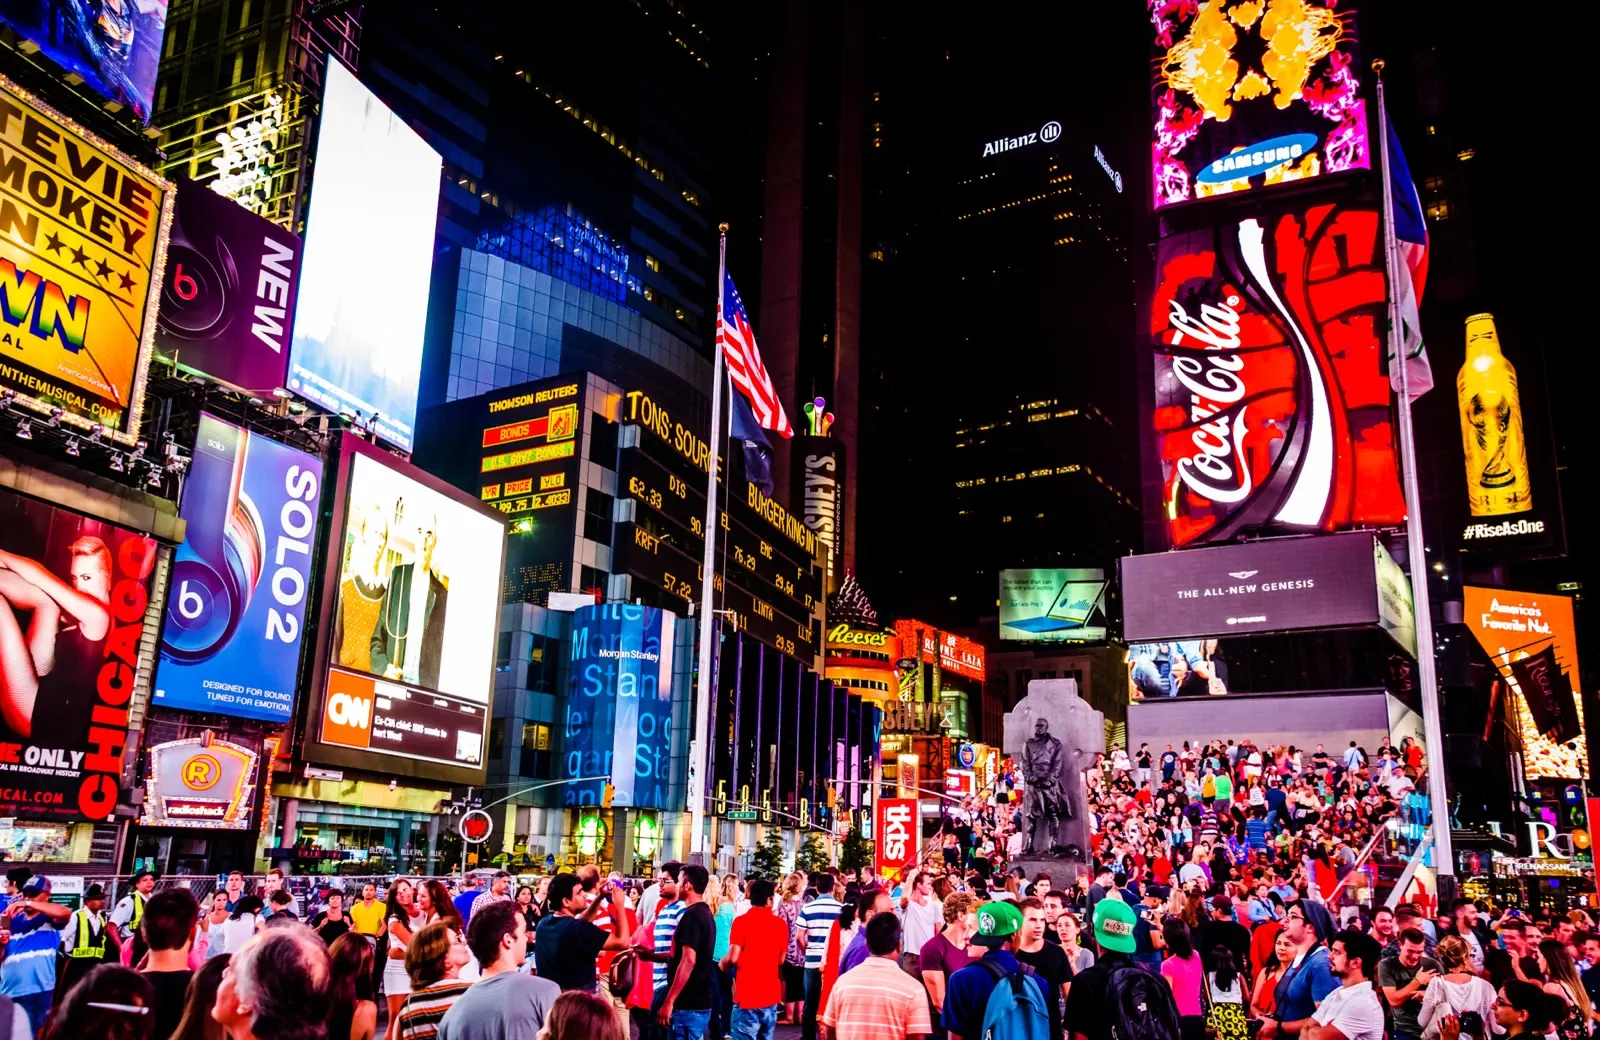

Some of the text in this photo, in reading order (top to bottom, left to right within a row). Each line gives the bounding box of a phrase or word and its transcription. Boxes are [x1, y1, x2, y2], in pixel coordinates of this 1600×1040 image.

[982, 132, 1038, 157] Allianz
[1093, 144, 1115, 182] Allianz
[1212, 143, 1303, 175] SAMSUNG
[251, 236, 294, 354] NEW
[489, 383, 578, 413] THOMSON REUTERS
[500, 424, 530, 439] BONDS
[207, 438, 225, 452] solo
[490, 455, 507, 467] U.S.
[535, 444, 566, 461] BONDS
[627, 391, 673, 444] TONS:
[748, 482, 786, 533] BURGER
[786, 513, 805, 547] KING
[806, 529, 815, 555] IN
[485, 475, 561, 498] YR PRICE YLD
[535, 492, 568, 507] 2.4033
[669, 475, 686, 499] DIS
[720, 512, 731, 531] EL
[760, 541, 773, 560] EMC
[1463, 519, 1545, 540] #RiseAsOne
[265, 465, 317, 644] SOLO 2
[635, 528, 660, 555] KRFT
[698, 565, 723, 592] LYA
[753, 598, 773, 622] LINTA
[734, 545, 756, 571] 76.29
[775, 573, 794, 596] 29.64
[804, 593, 816, 612] 17.
[1177, 579, 1314, 599] THE ALL-NEW GENESIS
[664, 572, 692, 600] 57.22
[775, 634, 795, 655] 29.53
[1489, 598, 1542, 617] America's
[1481, 613, 1527, 632] Favorite
[828, 623, 888, 646] Reese's
[599, 649, 660, 664] Morgan Stanley
[78, 536, 156, 820] CHICAGO
[202, 680, 292, 702] DESIGNED FOR SOUND.
[206, 691, 291, 712] TUNED FOR EMOTION.
[327, 692, 371, 729] CNN
[24, 745, 85, 770] ONLY
[18, 766, 55, 776] BROADWAY
[55, 769, 81, 778] HISTORY
[168, 804, 225, 816] radioshack
[886, 804, 912, 860] tkts
[1519, 863, 1572, 872] RENAISSAN
[60, 880, 76, 888] Here
